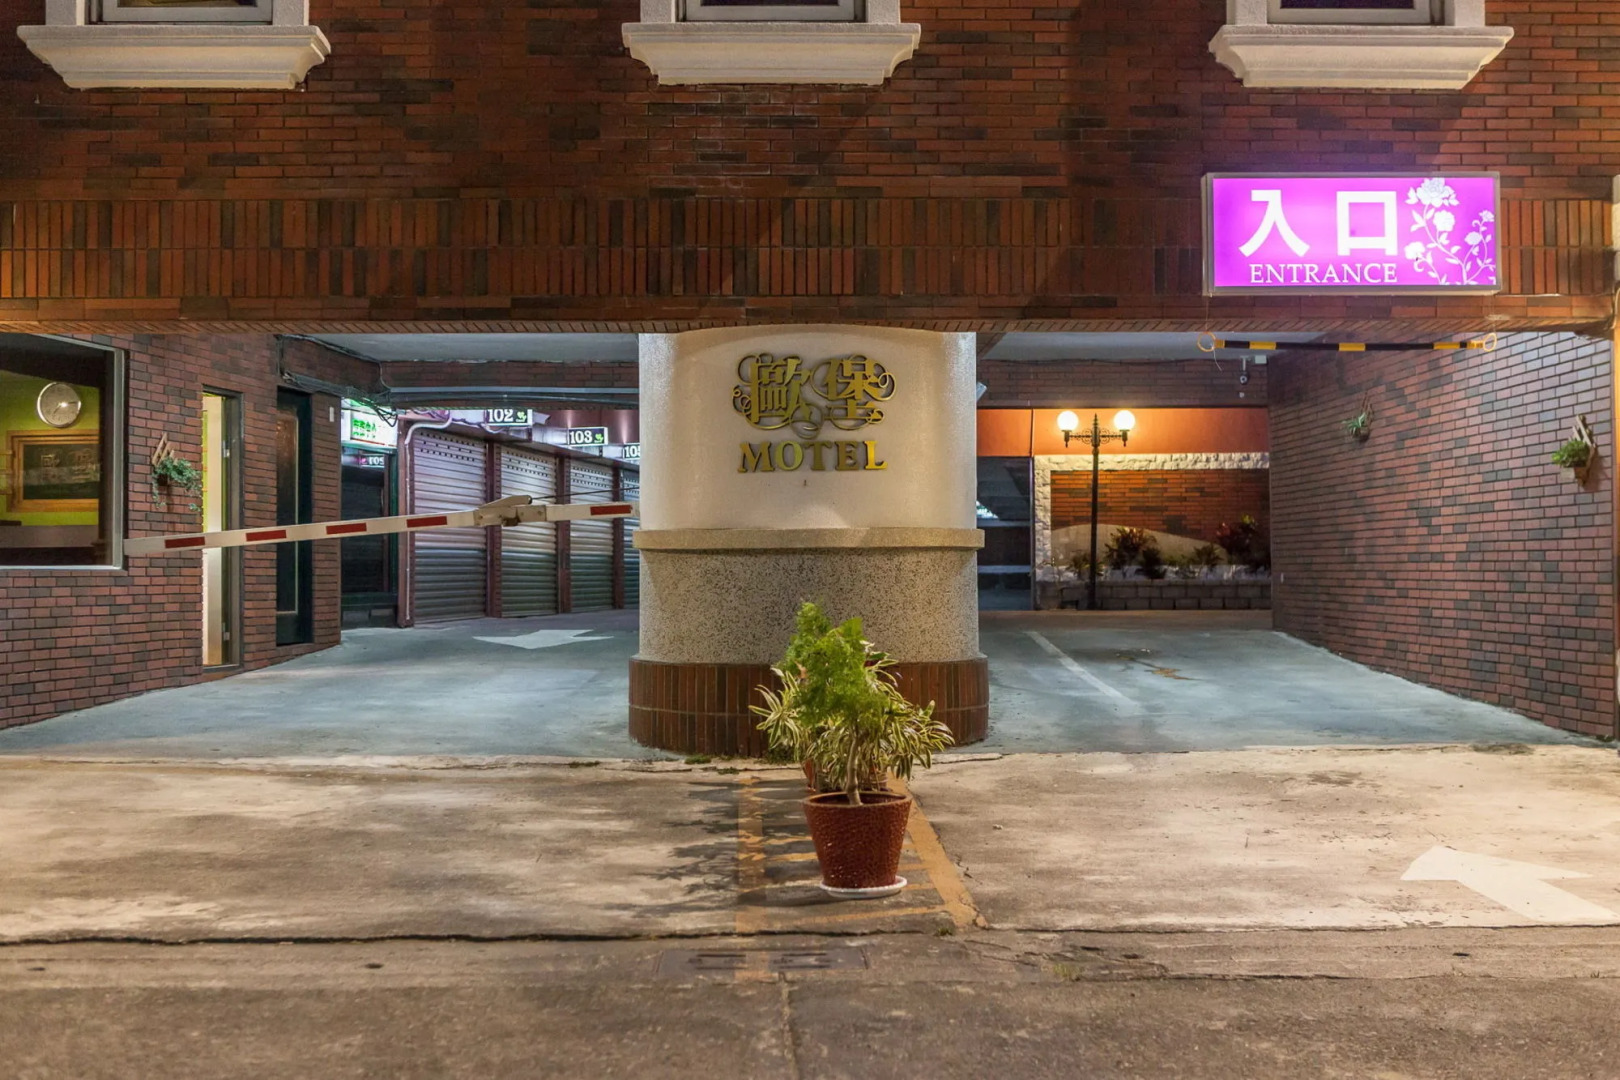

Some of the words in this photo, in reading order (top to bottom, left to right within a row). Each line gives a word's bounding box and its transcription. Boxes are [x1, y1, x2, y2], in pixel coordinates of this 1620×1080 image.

[1238, 189, 1398, 257] 入口
[1249, 263, 1398, 283] ENTRANCE
[487, 408, 514, 422] 102
[569, 430, 593, 444] 103
[737, 440, 889, 473] MOTEL
